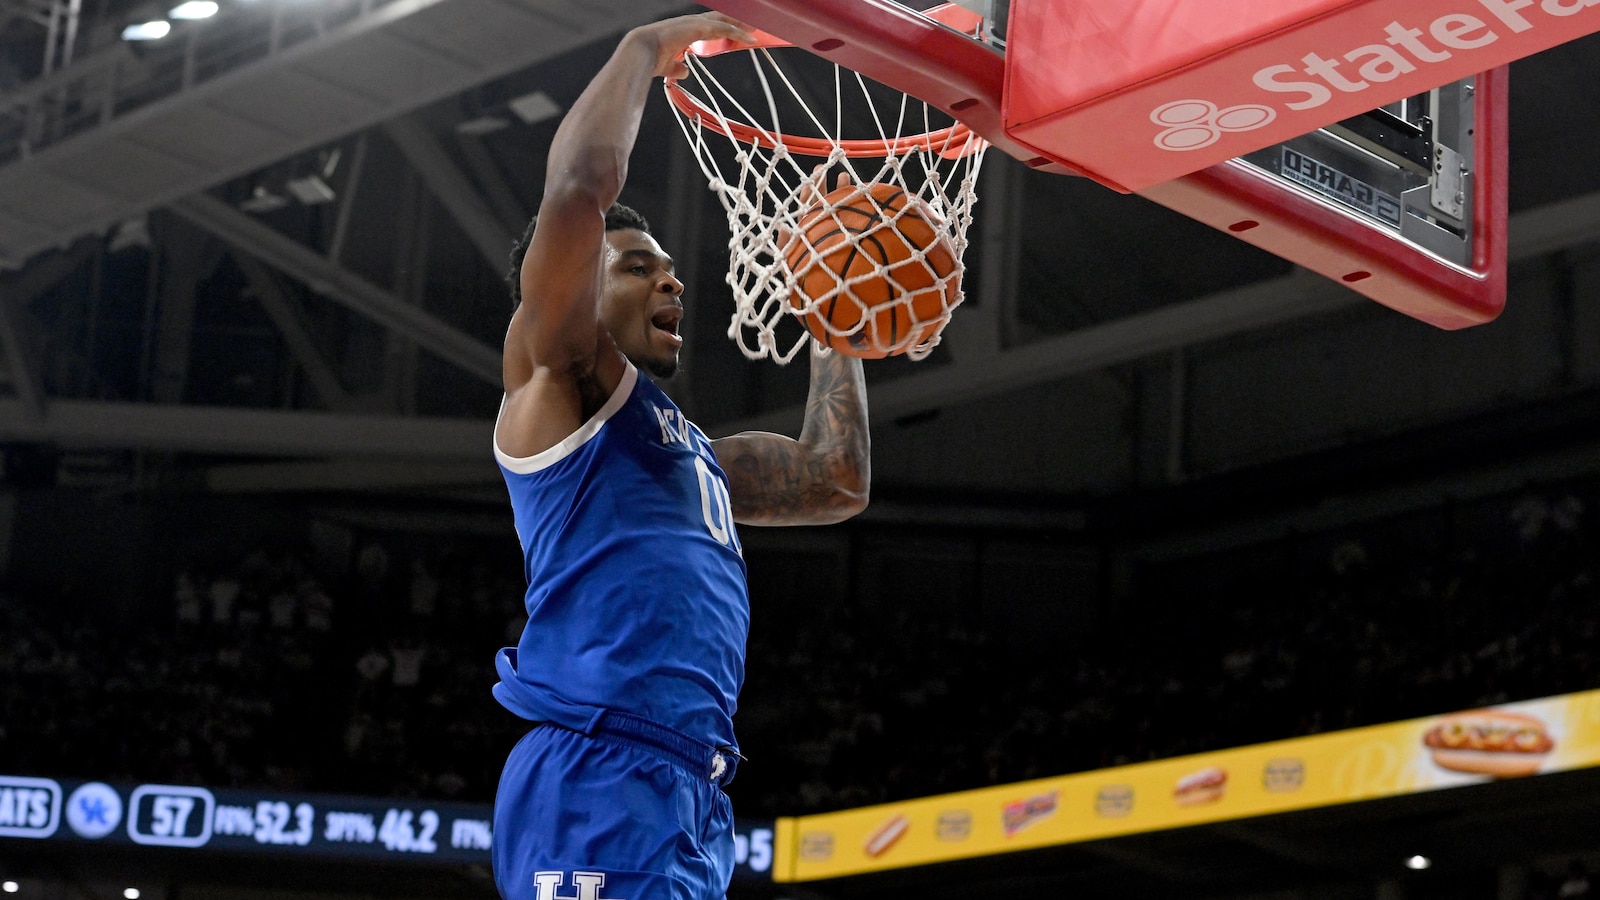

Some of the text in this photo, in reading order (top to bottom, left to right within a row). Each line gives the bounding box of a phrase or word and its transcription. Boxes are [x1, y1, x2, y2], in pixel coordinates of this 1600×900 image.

[151, 795, 195, 837] 57
[254, 800, 315, 846] 52.3
[378, 808, 440, 854] 46.2
